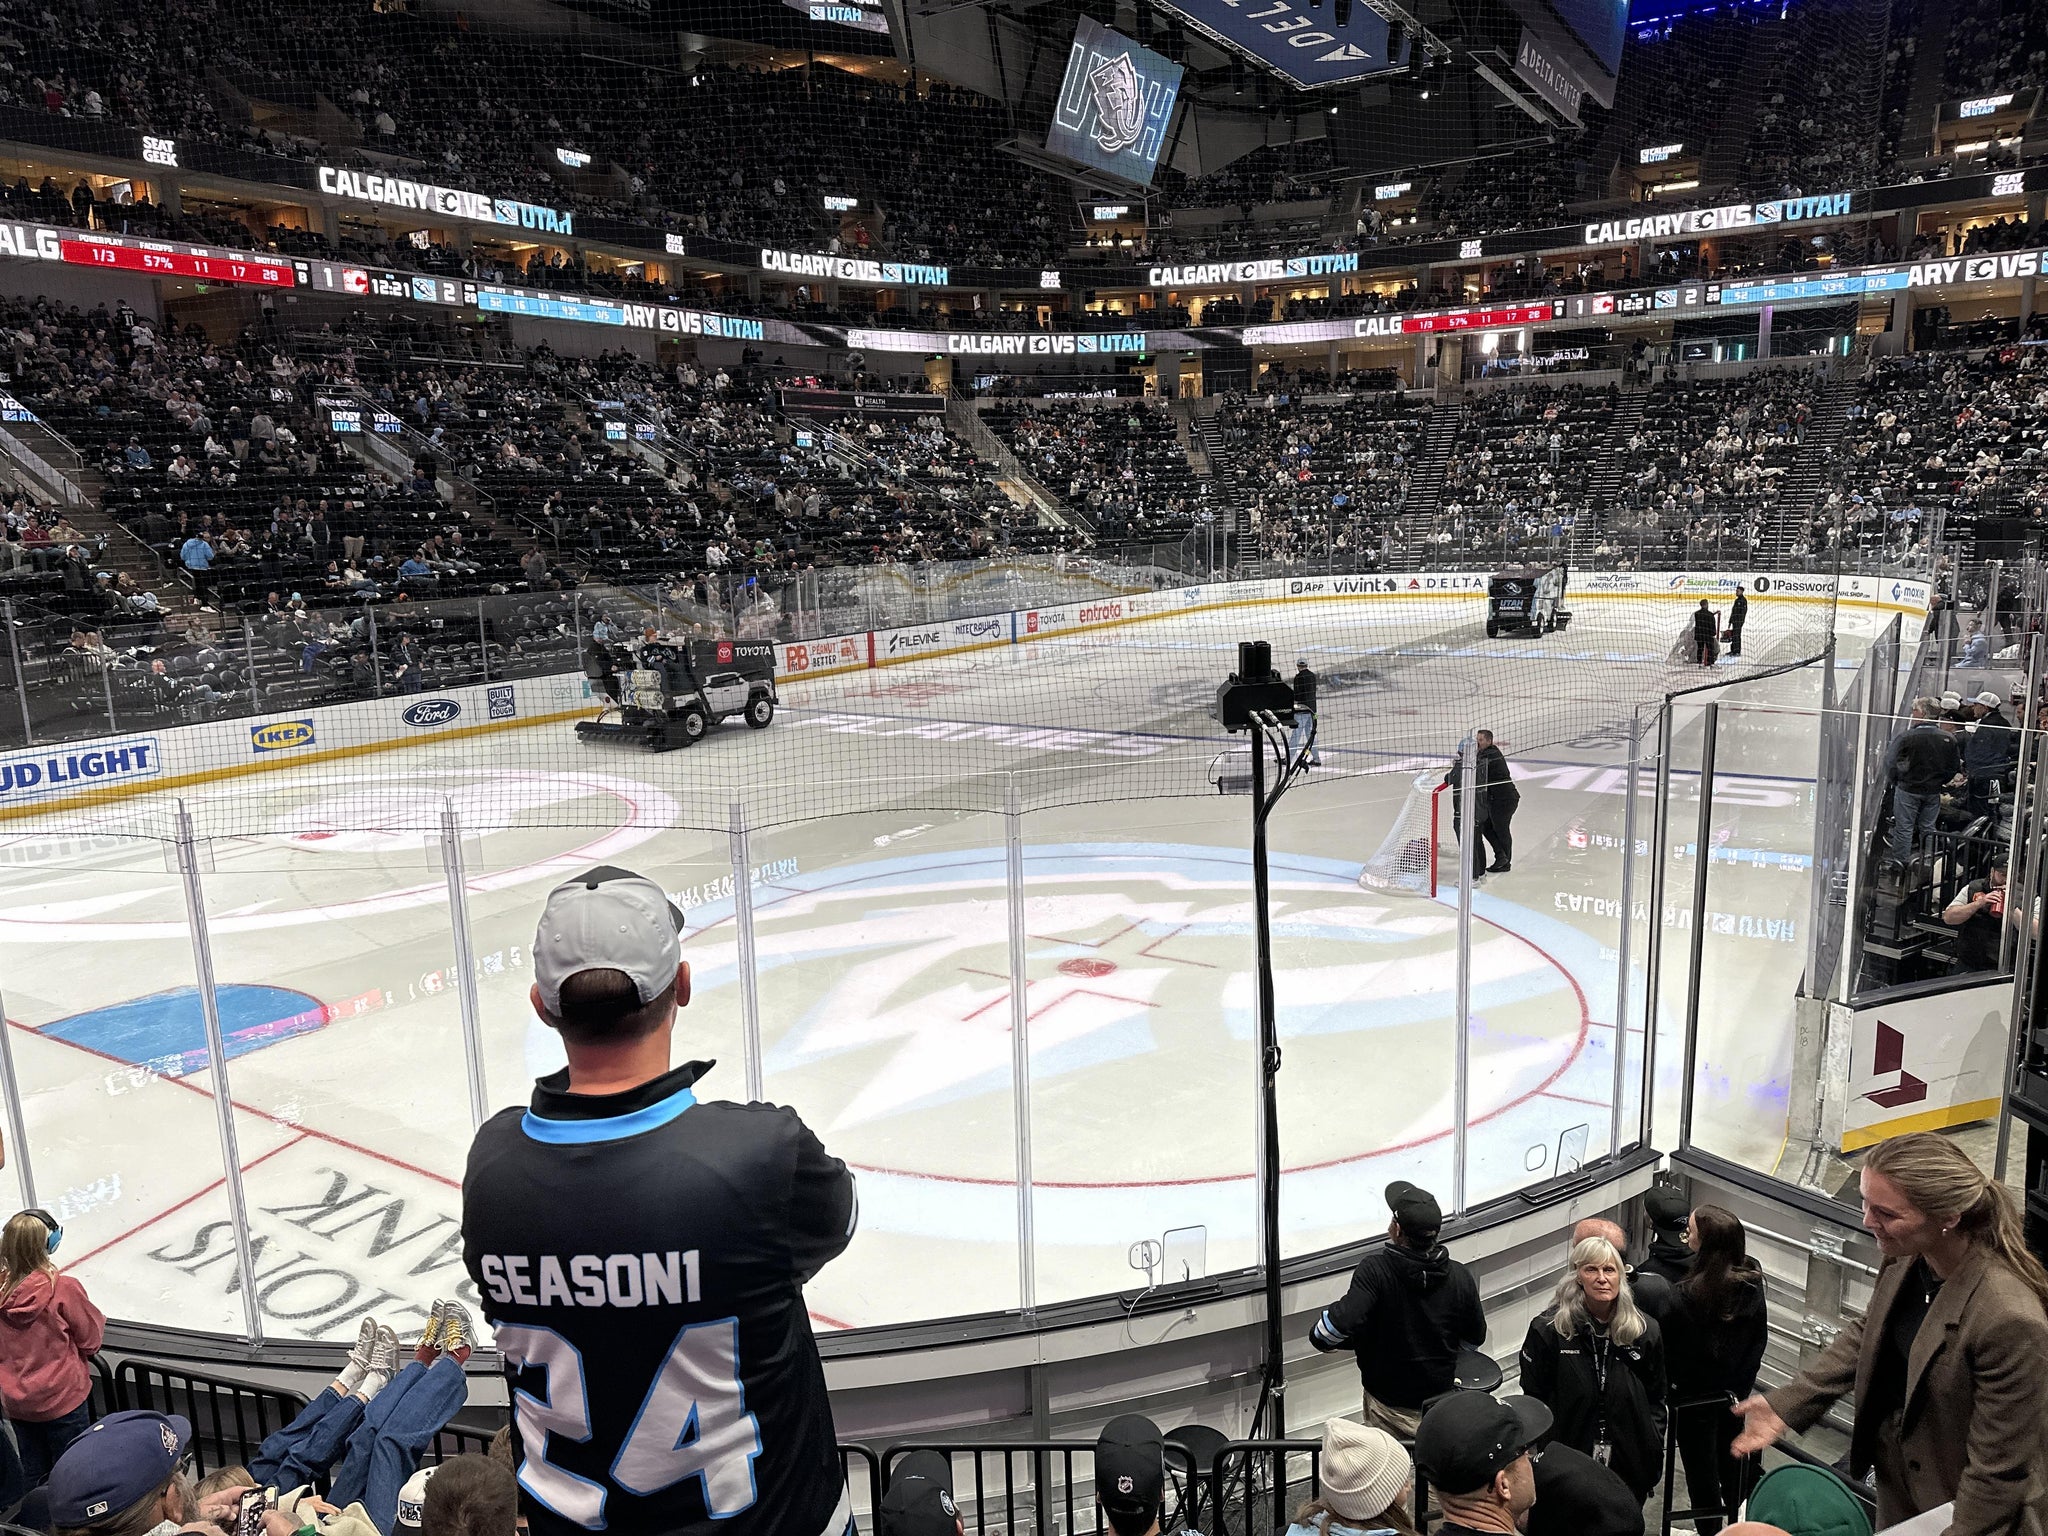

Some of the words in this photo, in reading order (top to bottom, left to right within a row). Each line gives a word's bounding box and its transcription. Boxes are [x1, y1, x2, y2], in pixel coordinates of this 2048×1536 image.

[827, 6, 862, 21] UTAH
[1222, 0, 1336, 48] DEL
[1529, 48, 1555, 87] DELTA
[1555, 73, 1581, 110] CENTER
[1057, 42, 1175, 161] UH
[1971, 94, 2014, 109] CALGARY
[1971, 105, 1996, 117] UTAH
[142, 135, 175, 153] SEAT
[1650, 144, 1683, 155] CALGARY
[143, 149, 179, 168] GEEK
[1649, 153, 1669, 163] UTAH
[1994, 172, 2025, 186] SEAT
[1991, 182, 2025, 196] GEEK
[319, 166, 432, 211] CALGARY
[463, 194, 493, 221] VS
[520, 206, 574, 236] UTAH
[1585, 213, 1687, 244] CALGARY
[1719, 205, 1751, 225] VS
[1785, 194, 1851, 220] UTAH
[665, 233, 684, 245] SEAT
[1461, 240, 1482, 251] SEAT
[92, 248, 116, 263] 1/3
[1460, 248, 1482, 259] GEEK
[143, 254, 174, 270] 57%
[194, 260, 209, 274] 11
[761, 248, 835, 277] CALGARY
[857, 259, 881, 281] VS
[903, 264, 949, 286] UTAH
[231, 265, 246, 278] 17
[262, 268, 279, 282] 28
[1040, 271, 1060, 280] SEAT
[1149, 264, 1232, 286] CALGARY
[1259, 259, 1284, 280] VS
[1310, 253, 1359, 275] UTAH
[1908, 260, 1962, 288] ARY
[2000, 252, 2038, 278] VS
[298, 271, 308, 285] 8
[323, 267, 335, 288] 1
[1040, 279, 1061, 288] GEEK
[1867, 277, 1887, 288] 0/5
[371, 277, 411, 299] 12:21
[1794, 286, 1806, 296] 11
[1821, 279, 1846, 292] 43%
[443, 283, 456, 302] 2
[464, 291, 478, 304] 28
[1685, 288, 1698, 304] 2
[1707, 292, 1721, 303] 28
[1735, 290, 1749, 300] 52
[1763, 287, 1776, 298] 16
[515, 300, 526, 310] 16
[539, 302, 550, 312] 11
[561, 304, 581, 317] 43%
[1576, 299, 1584, 315] 1
[1617, 296, 1652, 312] 12:21
[594, 309, 610, 320] 0/5
[1481, 314, 1491, 323] 11
[1507, 312, 1517, 321] 17
[1528, 310, 1541, 319] 28
[622, 304, 656, 328] ARY
[678, 310, 702, 334] VS
[722, 318, 764, 340] UTAH
[1355, 316, 1402, 337] CALG
[1419, 320, 1433, 330] 1/3
[1449, 317, 1468, 326] 57%
[847, 330, 865, 341] SEAT
[1242, 327, 1263, 338] SEAT
[948, 334, 1026, 354] CALGARY
[1049, 335, 1075, 353] VS
[1099, 334, 1146, 352] UTAH
[333, 422, 350, 432] UTA
[1333, 577, 1382, 593] vivint
[1426, 577, 1483, 589] DELTA
[1585, 581, 1618, 589] AMERICA
[1619, 581, 1640, 589] FIRST
[1772, 579, 1835, 593] 1Password
[1903, 587, 1925, 599] moxie
[1500, 599, 1524, 607] UTAH
[1079, 602, 1121, 623] entrata
[1040, 613, 1066, 626] TOYOTA
[898, 632, 940, 648] FILEVINE
[735, 645, 772, 657] TOYOTA
[812, 642, 836, 654] PEANUT
[812, 655, 837, 668] BETTER
[490, 689, 512, 699] BUILT
[413, 703, 451, 724] Ford
[491, 707, 514, 717] TOUGH
[256, 725, 313, 747] IKEA
[47, 745, 150, 783] LIGHT
[147, 1220, 432, 1341] IONS
[480, 1249, 701, 1308] SEASON1
[493, 1315, 764, 1531] 24
